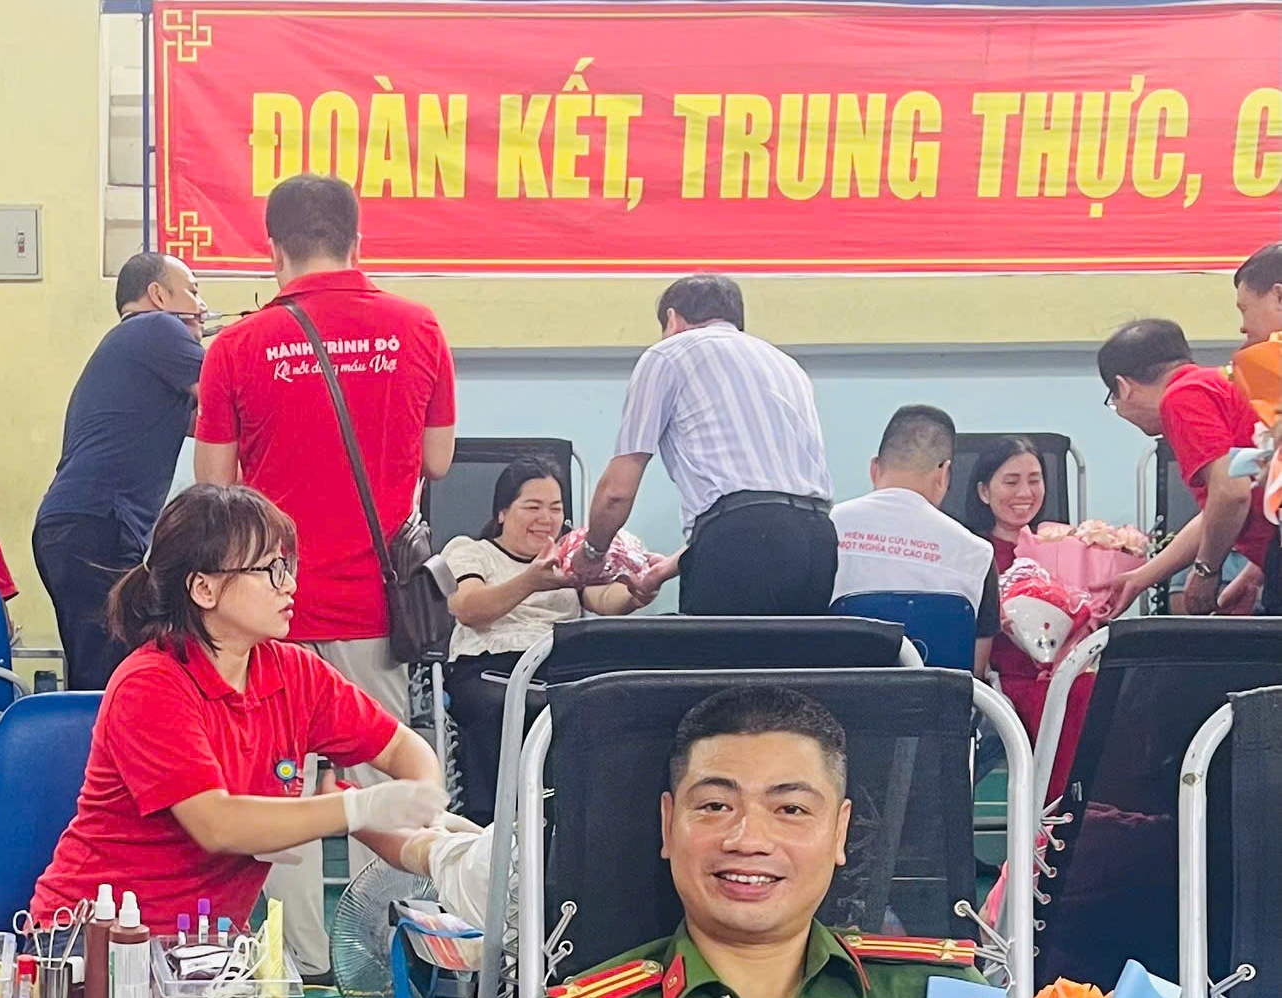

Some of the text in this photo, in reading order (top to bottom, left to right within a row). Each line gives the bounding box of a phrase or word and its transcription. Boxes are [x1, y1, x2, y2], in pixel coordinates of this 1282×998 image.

[248, 75, 469, 198] ĐOÀN
[496, 56, 643, 211] KẾT,
[673, 90, 943, 200] TRUNG
[972, 74, 1202, 218] THỰC,
[265, 341, 315, 362] HÀNH
[374, 334, 401, 353] ĐỎ
[339, 358, 368, 373] máu
[903, 547, 923, 559] CAO
